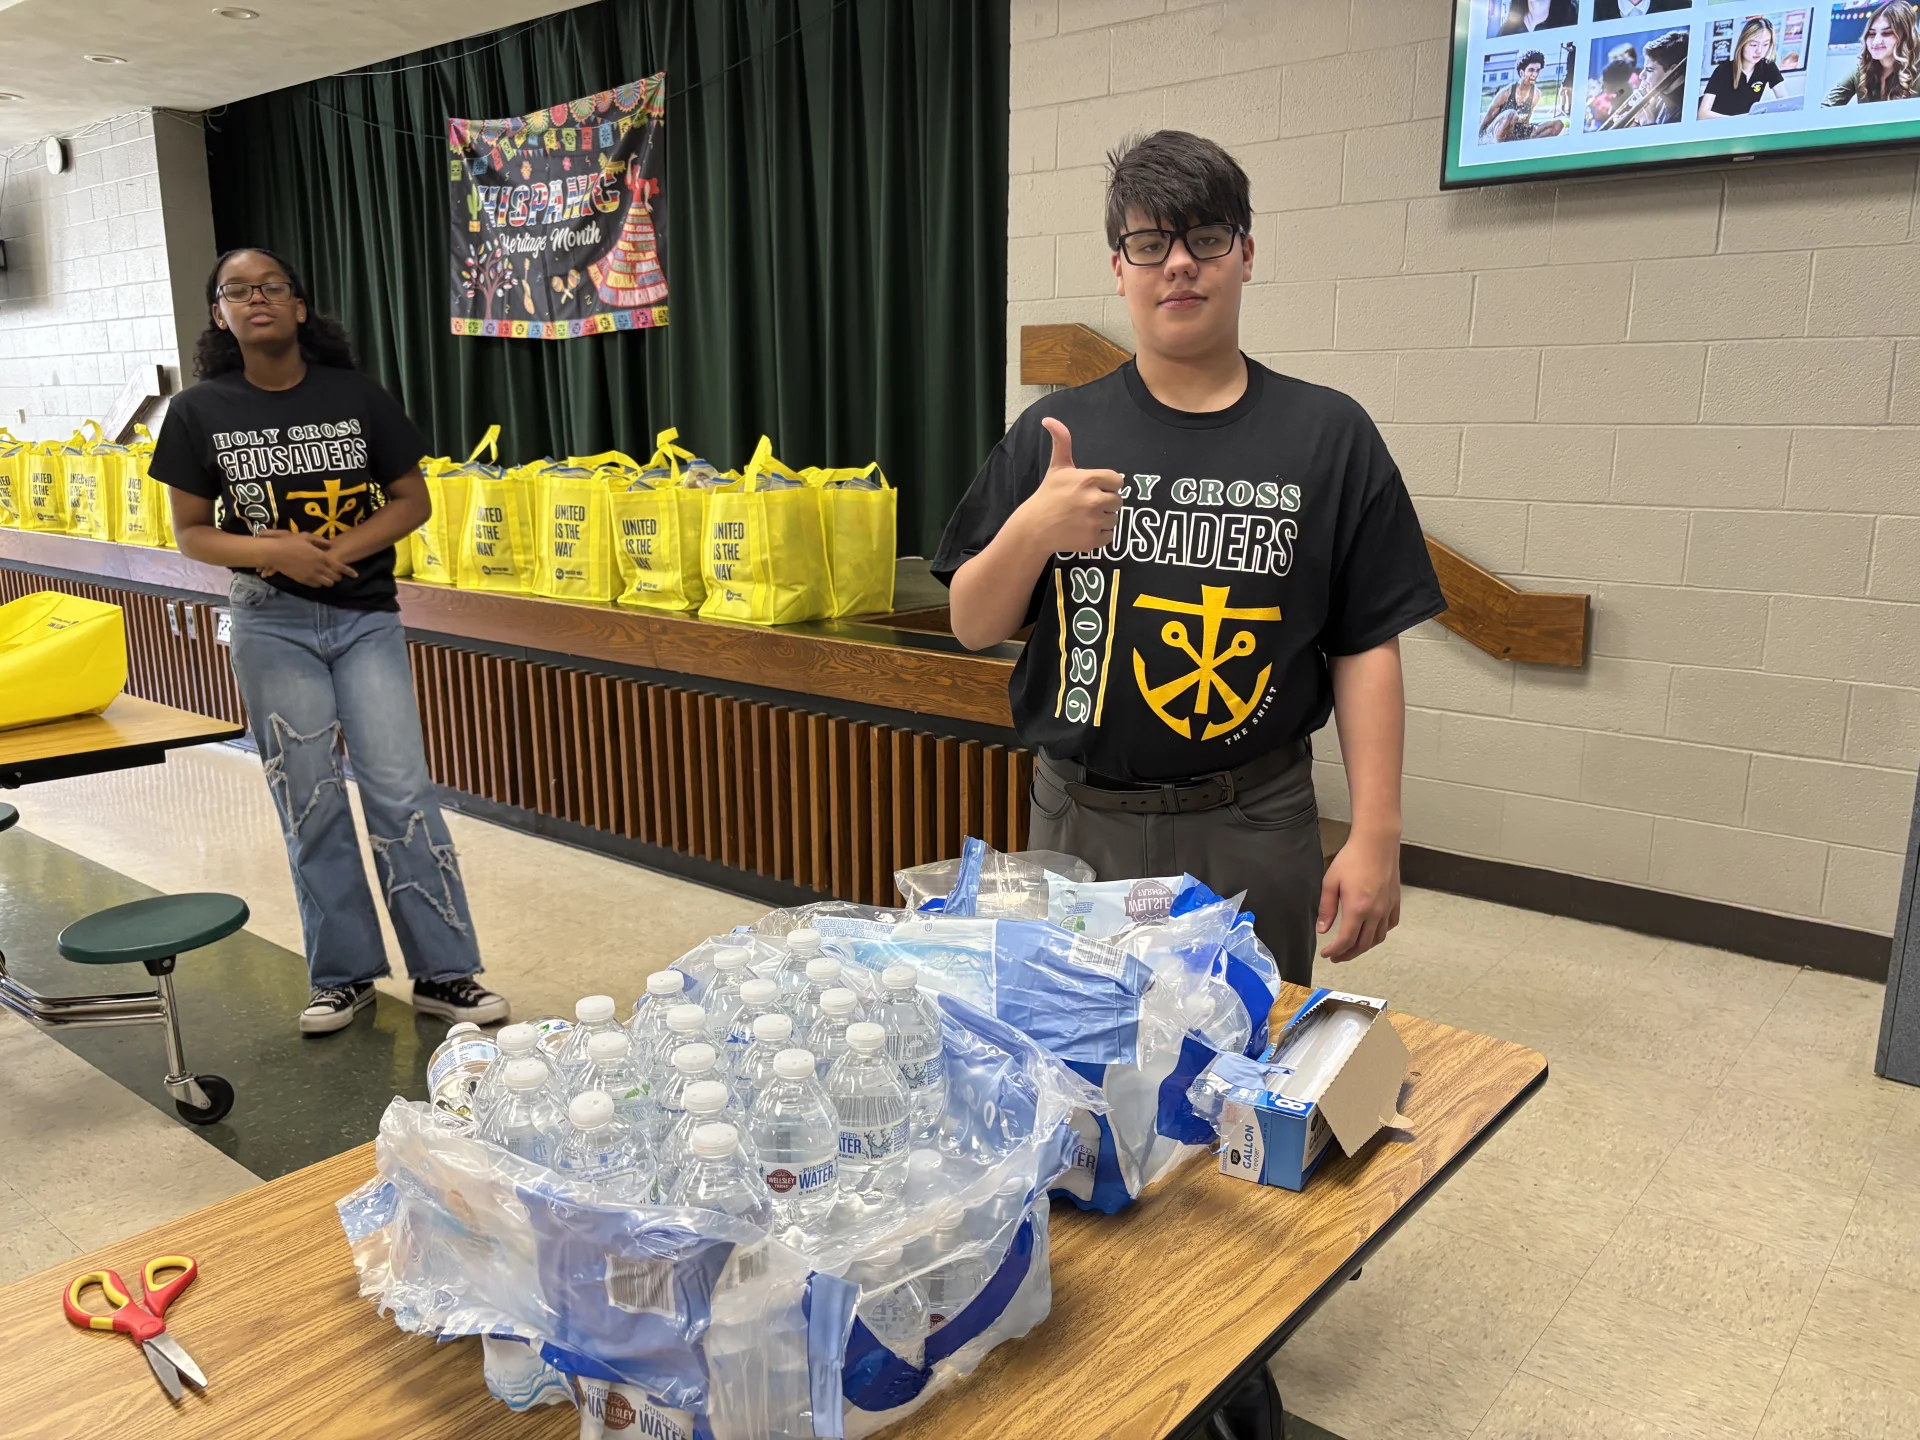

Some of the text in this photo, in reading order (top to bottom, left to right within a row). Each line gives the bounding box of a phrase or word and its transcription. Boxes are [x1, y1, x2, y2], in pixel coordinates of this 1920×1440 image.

[477, 171, 620, 228] HISPANIC
[499, 220, 602, 259] Heritage Month
[212, 419, 362, 450] HOLY CROSS
[217, 438, 368, 481] CRUSADERS
[1171, 478, 1302, 512] CROSS
[554, 504, 586, 521] UNITED
[482, 525, 500, 540] THE
[554, 522, 581, 540] IS THE
[622, 518, 657, 535] UNITED
[713, 522, 745, 540] UNITED
[625, 538, 652, 555] IS THE
[713, 543, 741, 561] IS THE
[1055, 506, 1299, 577] USADERS
[1065, 566, 1105, 725] 2026
[1224, 686, 1277, 746] THE SHIRT
[1242, 1124, 1255, 1170] GALLON
[799, 1164, 834, 1190] WATER
[803, 1160, 832, 1173] PURIFIED
[768, 1175, 796, 1184] WELLSLEY
[586, 1383, 608, 1397] PURIF
